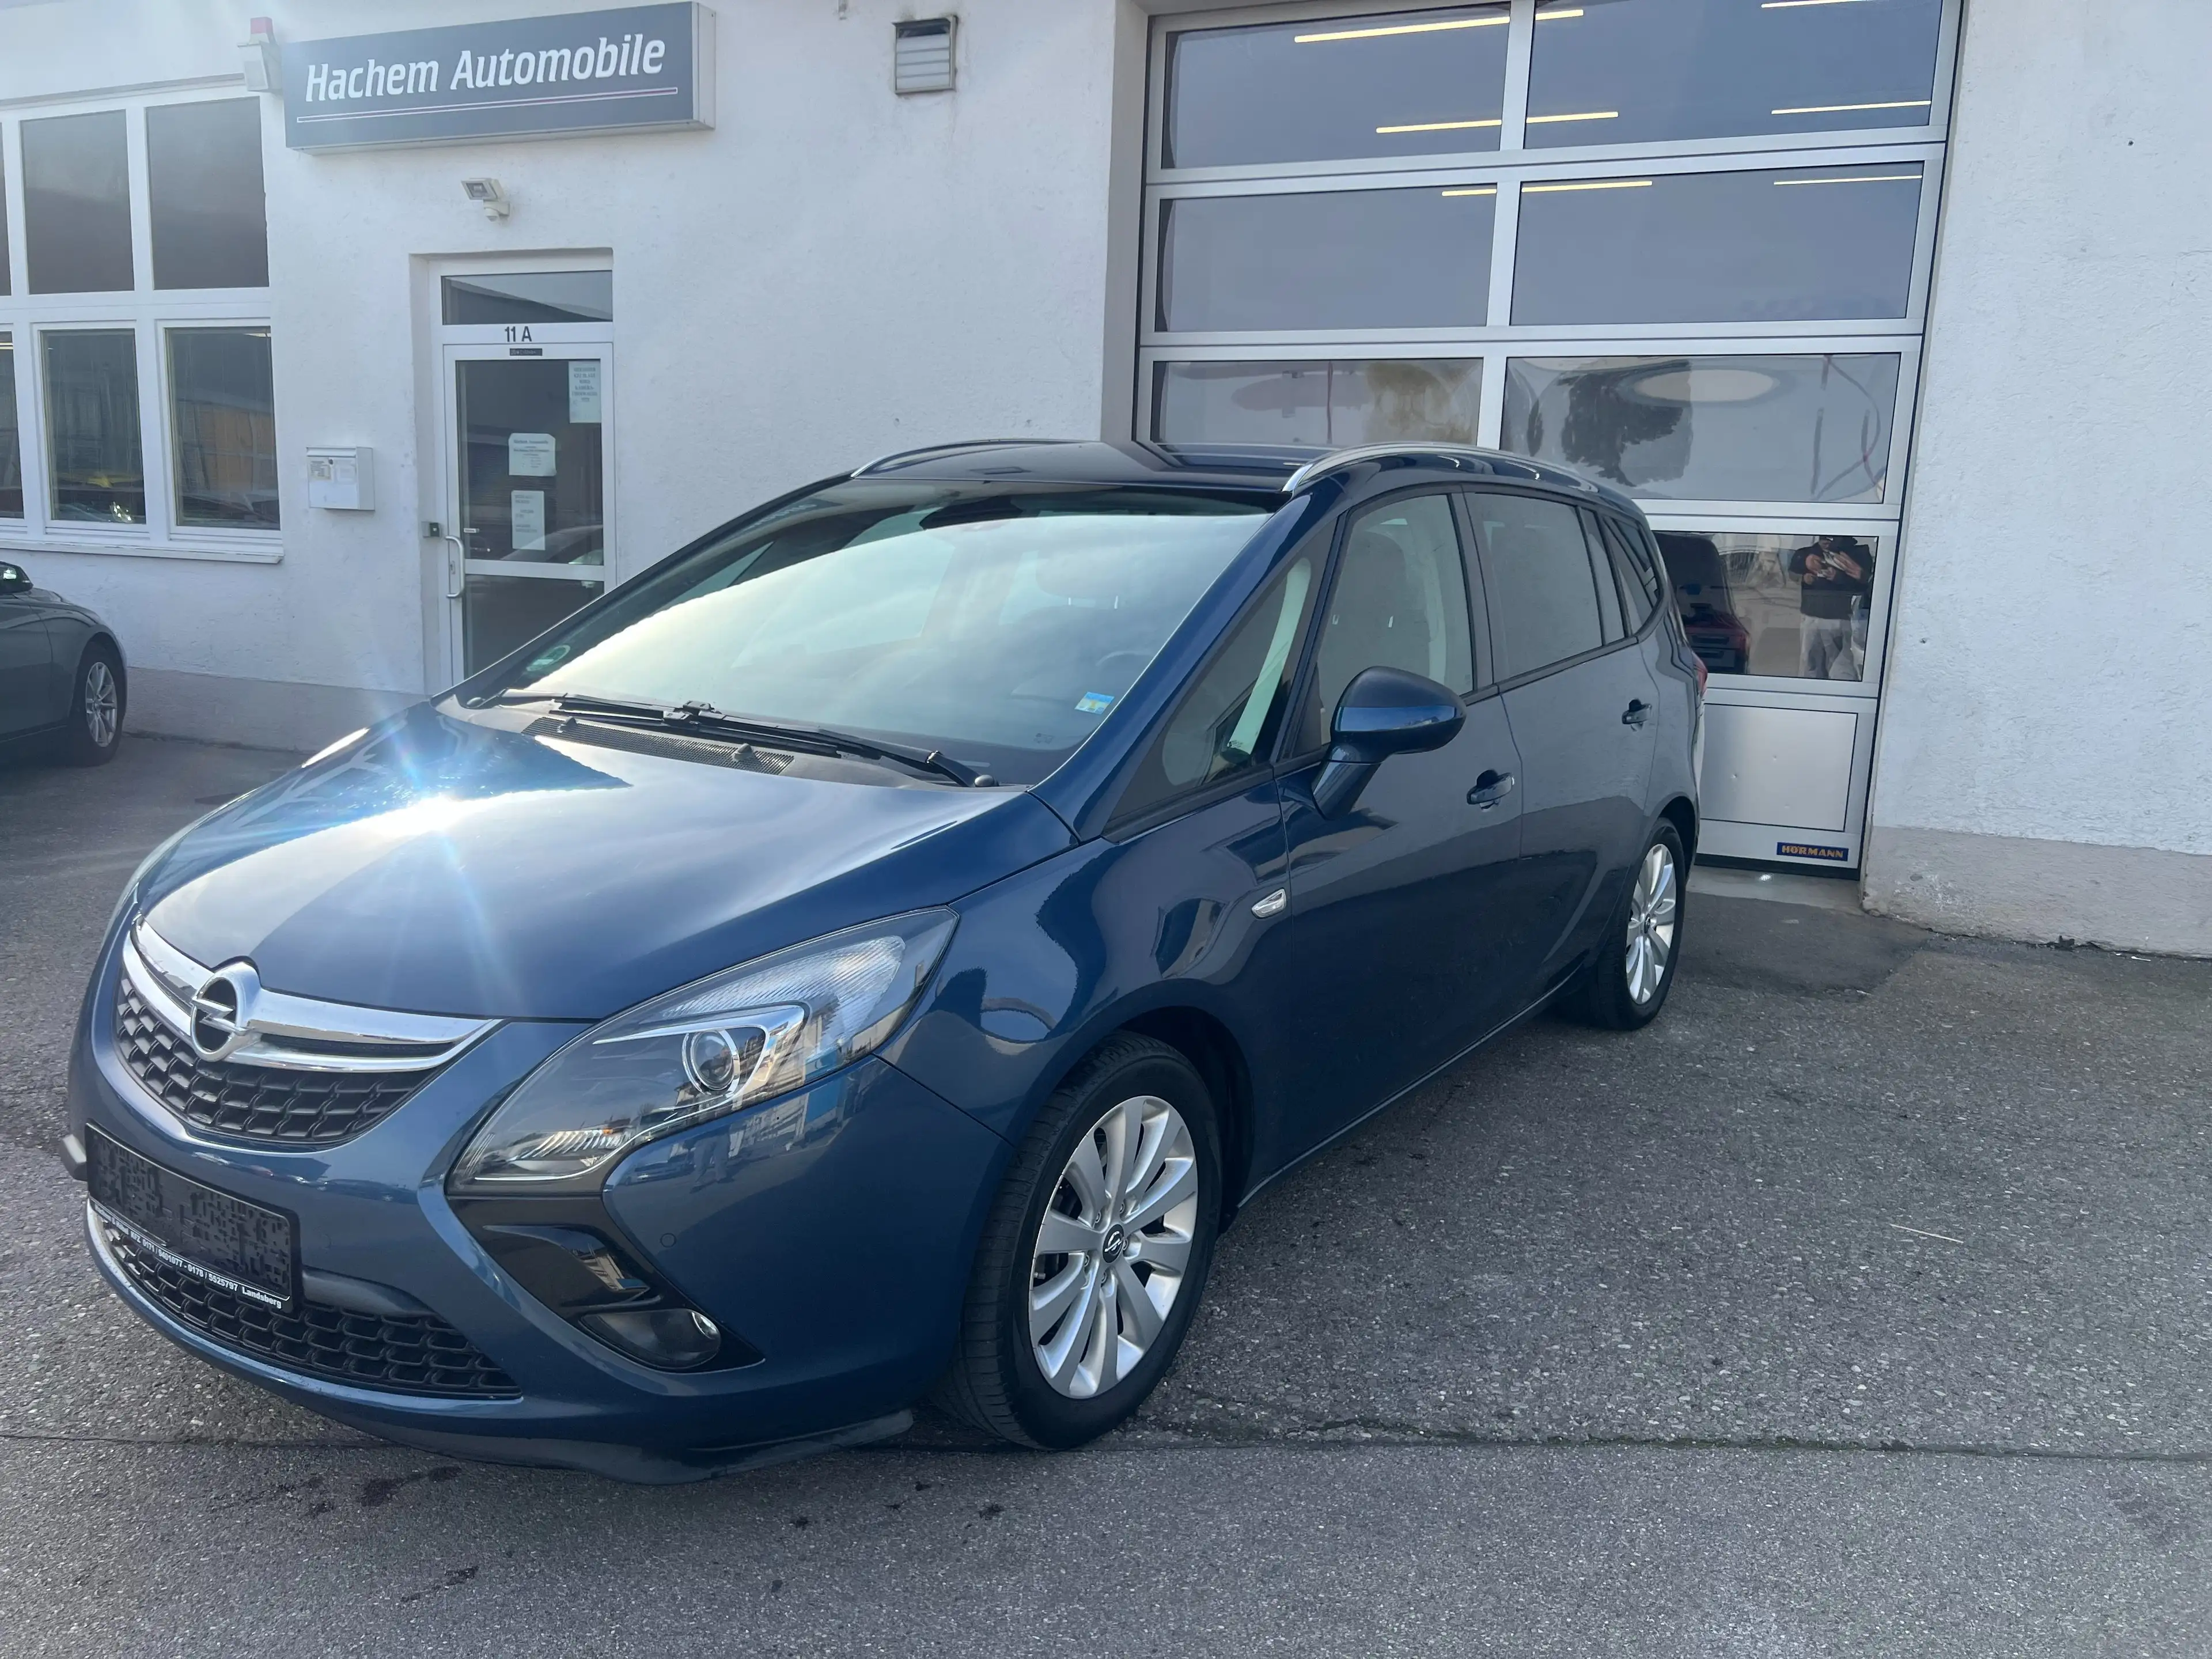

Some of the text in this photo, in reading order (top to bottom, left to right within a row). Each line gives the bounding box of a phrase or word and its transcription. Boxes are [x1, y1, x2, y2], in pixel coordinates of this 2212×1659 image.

[305, 33, 666, 103] Hachem Automobile
[504, 325, 532, 342] 11 A
[208, 1272, 238, 1291] 5525797
[242, 1286, 282, 1309] Landsberg
